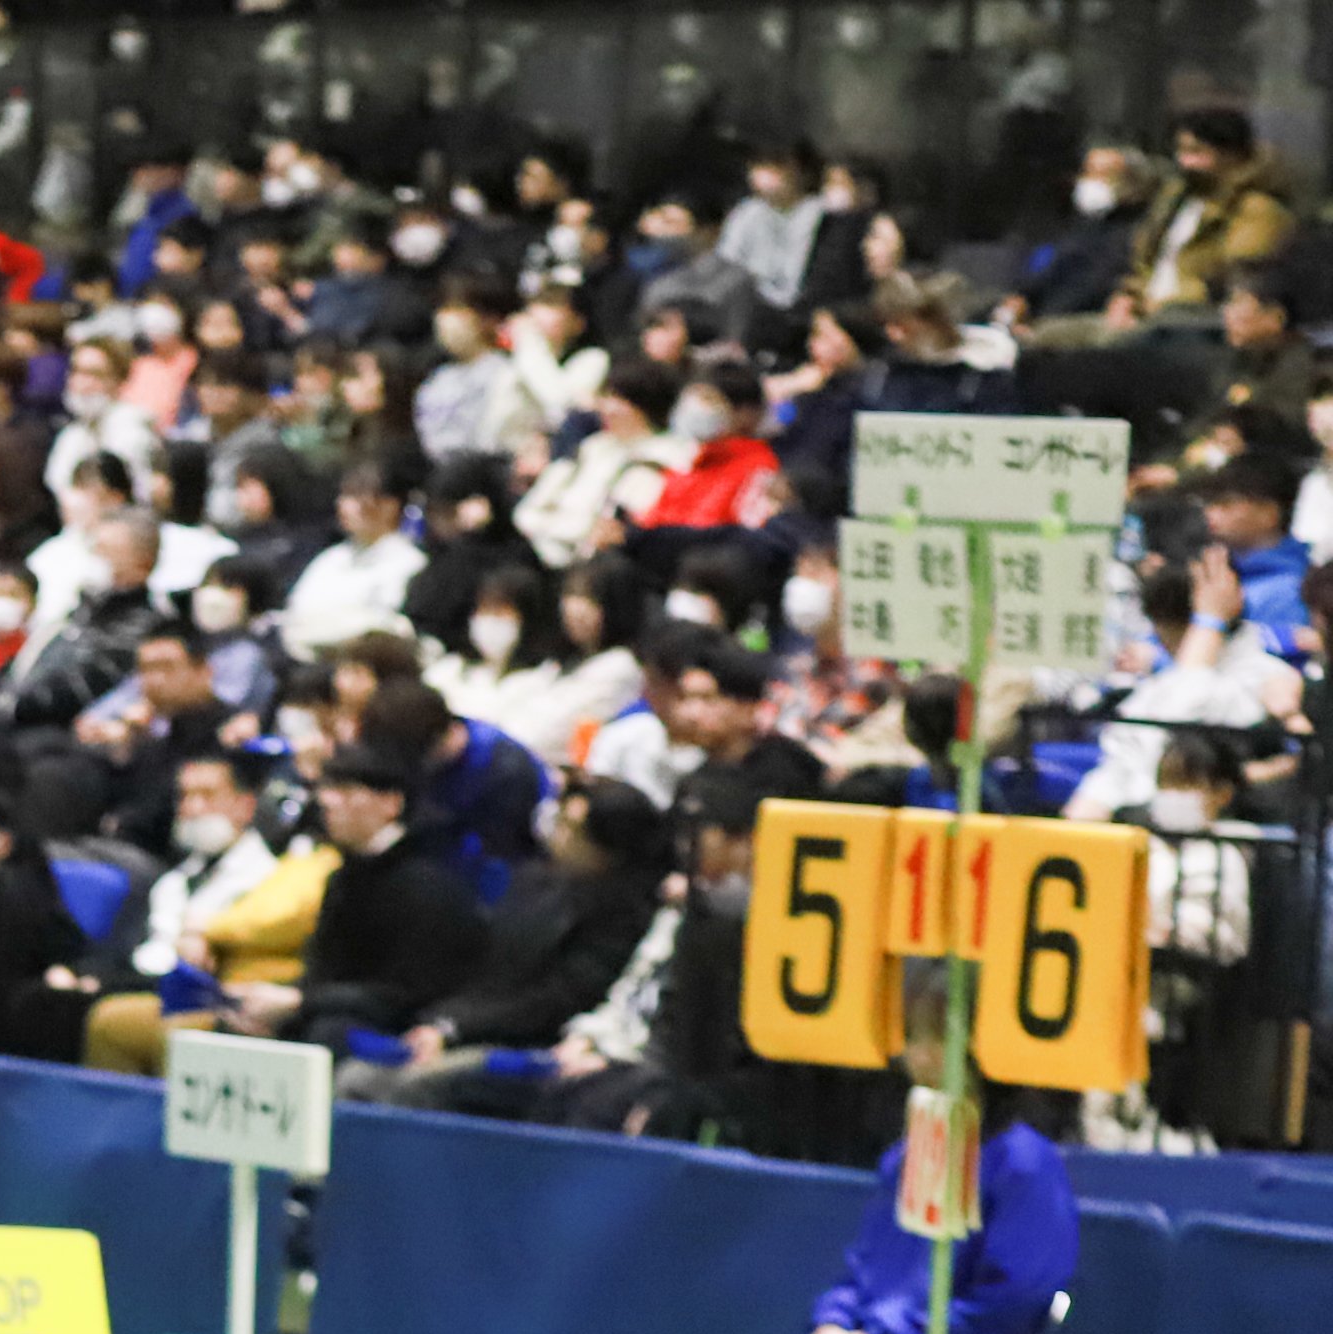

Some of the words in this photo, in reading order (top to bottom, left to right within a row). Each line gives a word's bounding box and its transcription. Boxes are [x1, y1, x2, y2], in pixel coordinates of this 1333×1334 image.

[779, 836, 847, 1016] 5
[905, 835, 930, 944] 1
[968, 839, 993, 949] 1
[1016, 855, 1087, 1040] 6
